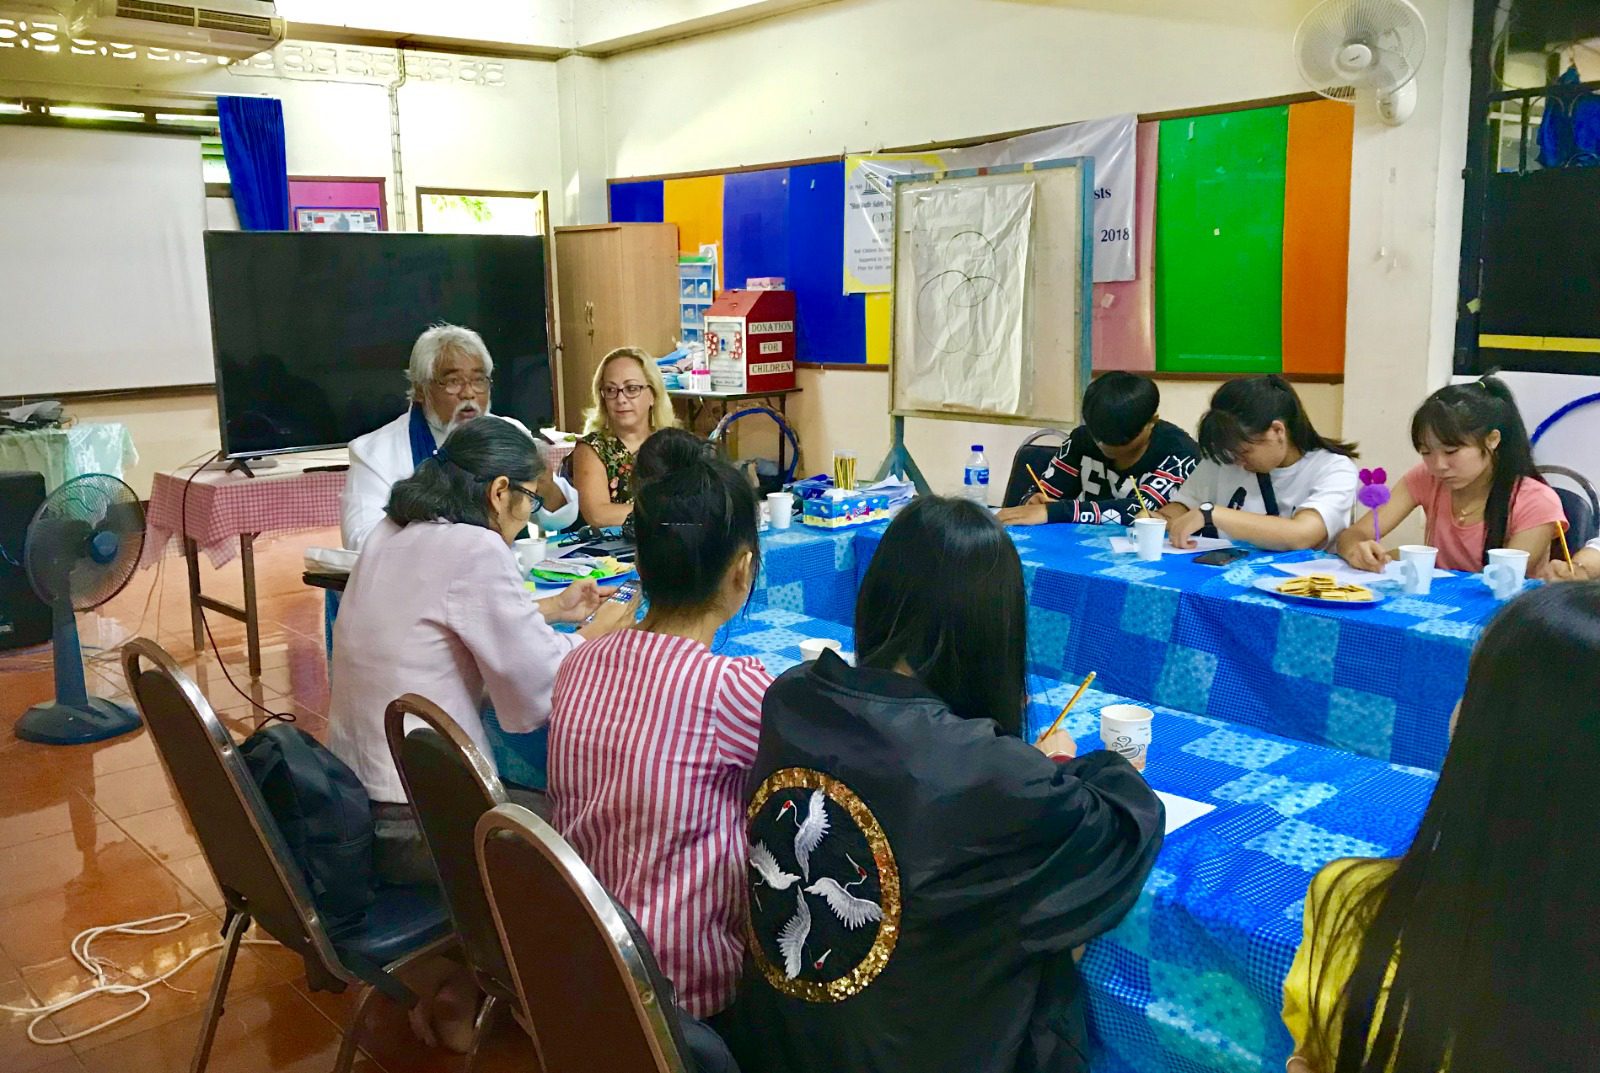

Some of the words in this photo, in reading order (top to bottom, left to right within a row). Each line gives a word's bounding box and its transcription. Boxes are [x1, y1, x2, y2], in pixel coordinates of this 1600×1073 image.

[1101, 228, 1130, 242] 2018
[751, 321, 792, 333] DONATION
[763, 343, 779, 352] FOR
[751, 363, 791, 374] CHILDREN
